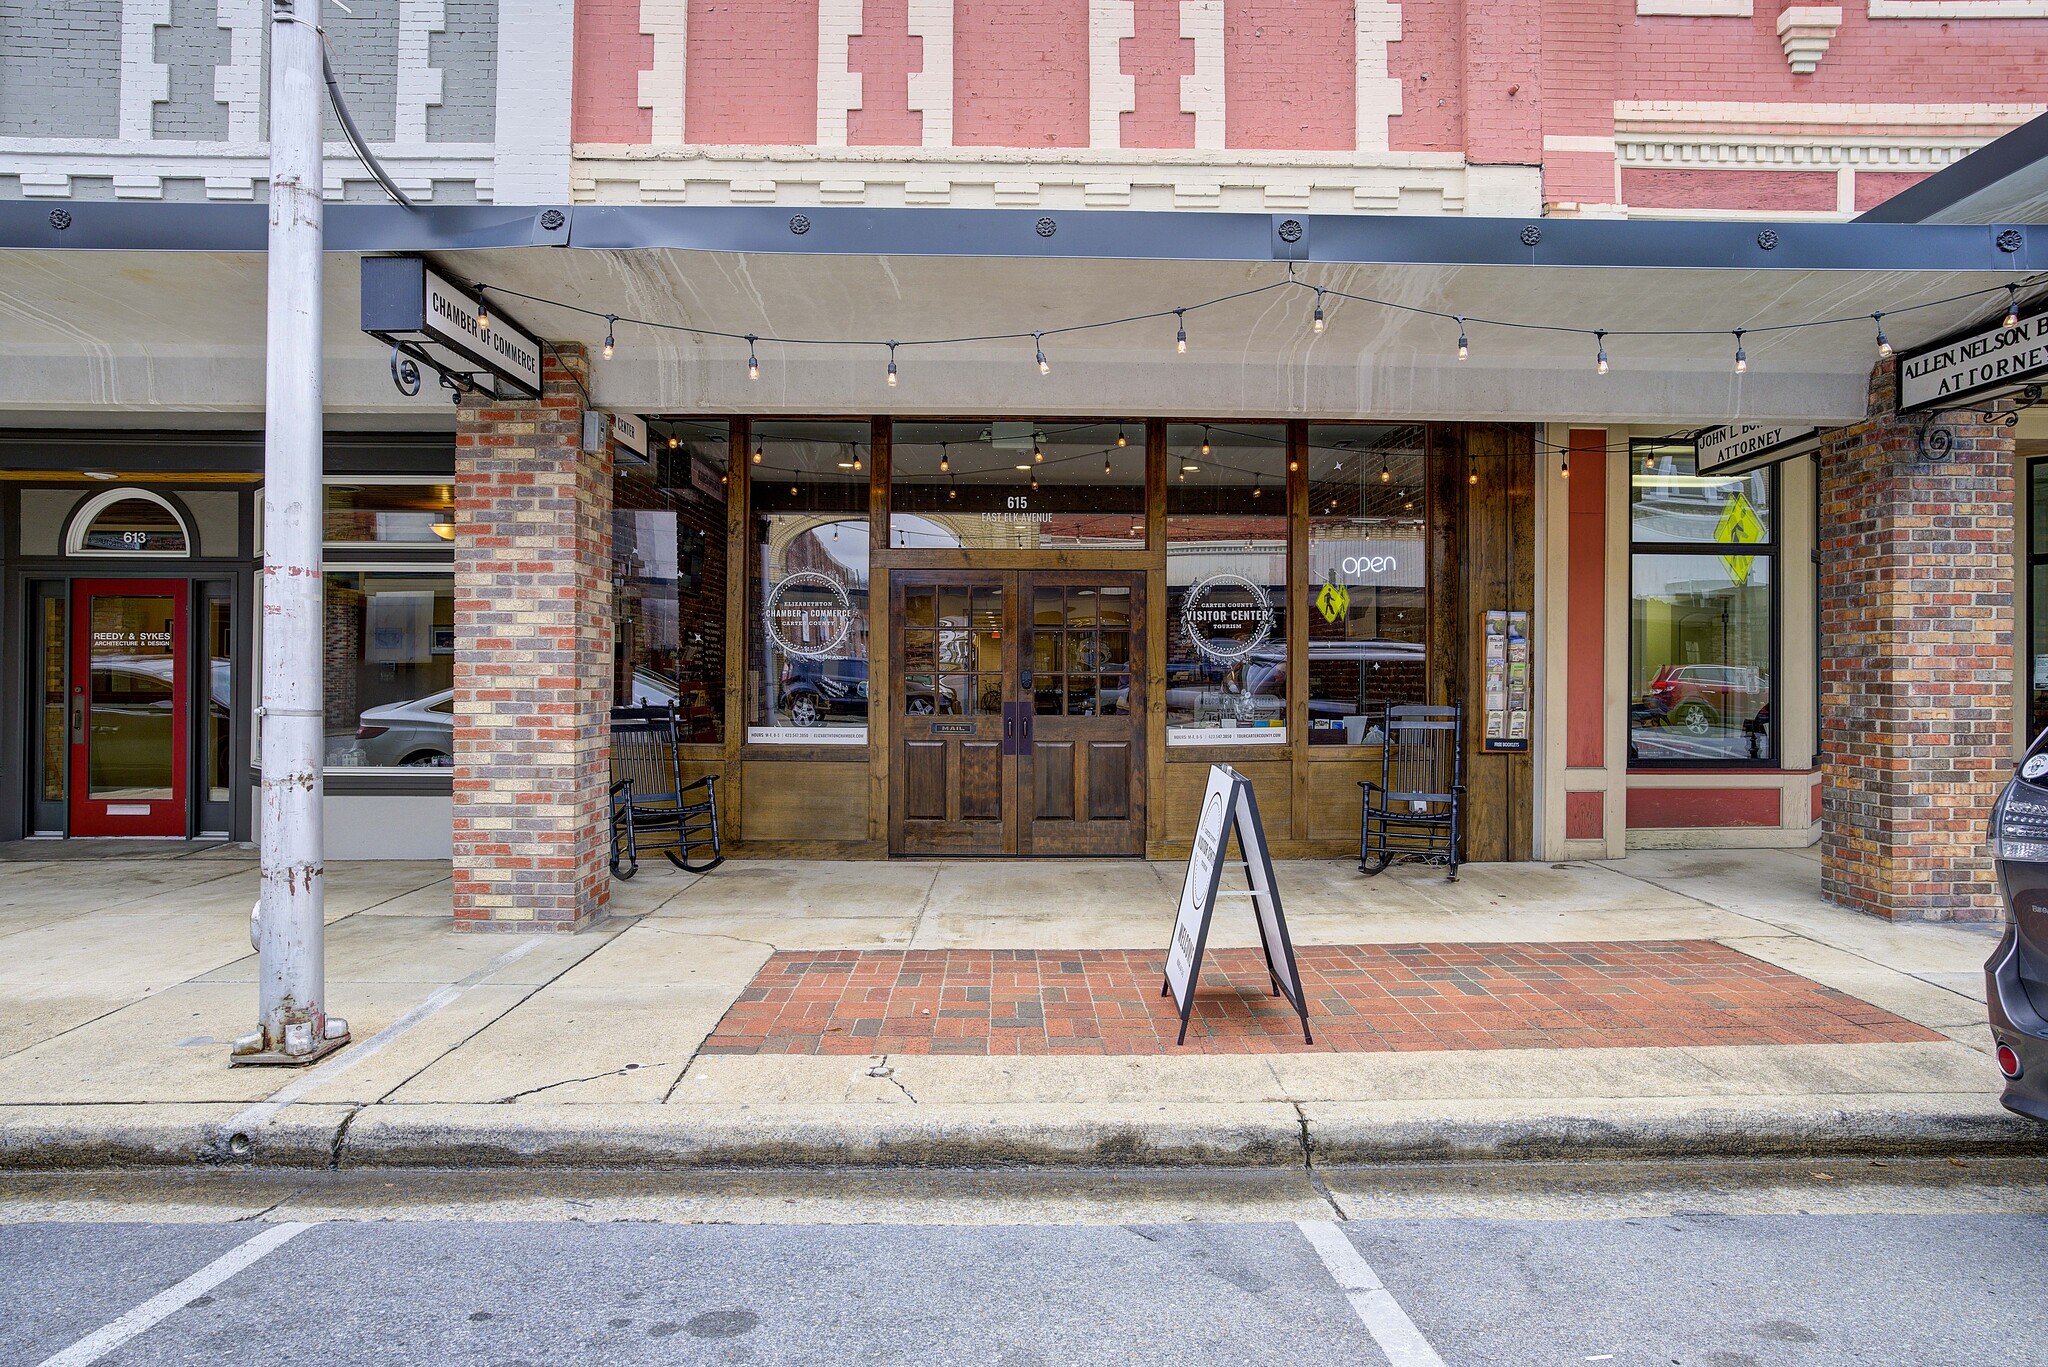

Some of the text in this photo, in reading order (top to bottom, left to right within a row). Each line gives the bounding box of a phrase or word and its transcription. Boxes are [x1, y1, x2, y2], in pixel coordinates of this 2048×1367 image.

[432, 292, 536, 375] CHAMBER OF COMMERCE
[1905, 349, 1957, 379] ALLEN,
[1959, 323, 2031, 363] NELSON,
[617, 417, 635, 439] CENTER
[1699, 428, 1727, 449] JOHN
[1717, 427, 1782, 462] ATTORNEY
[1007, 496, 1028, 509] 615
[981, 512, 1053, 523] EAST ELK AVENUE
[123, 532, 147, 544] 613
[1342, 556, 1396, 578] open
[766, 609, 851, 617] CHAMBER COMMERCE
[1186, 610, 1269, 621] VISITOR CENTER
[93, 632, 171, 640] REEDY & SYKES
